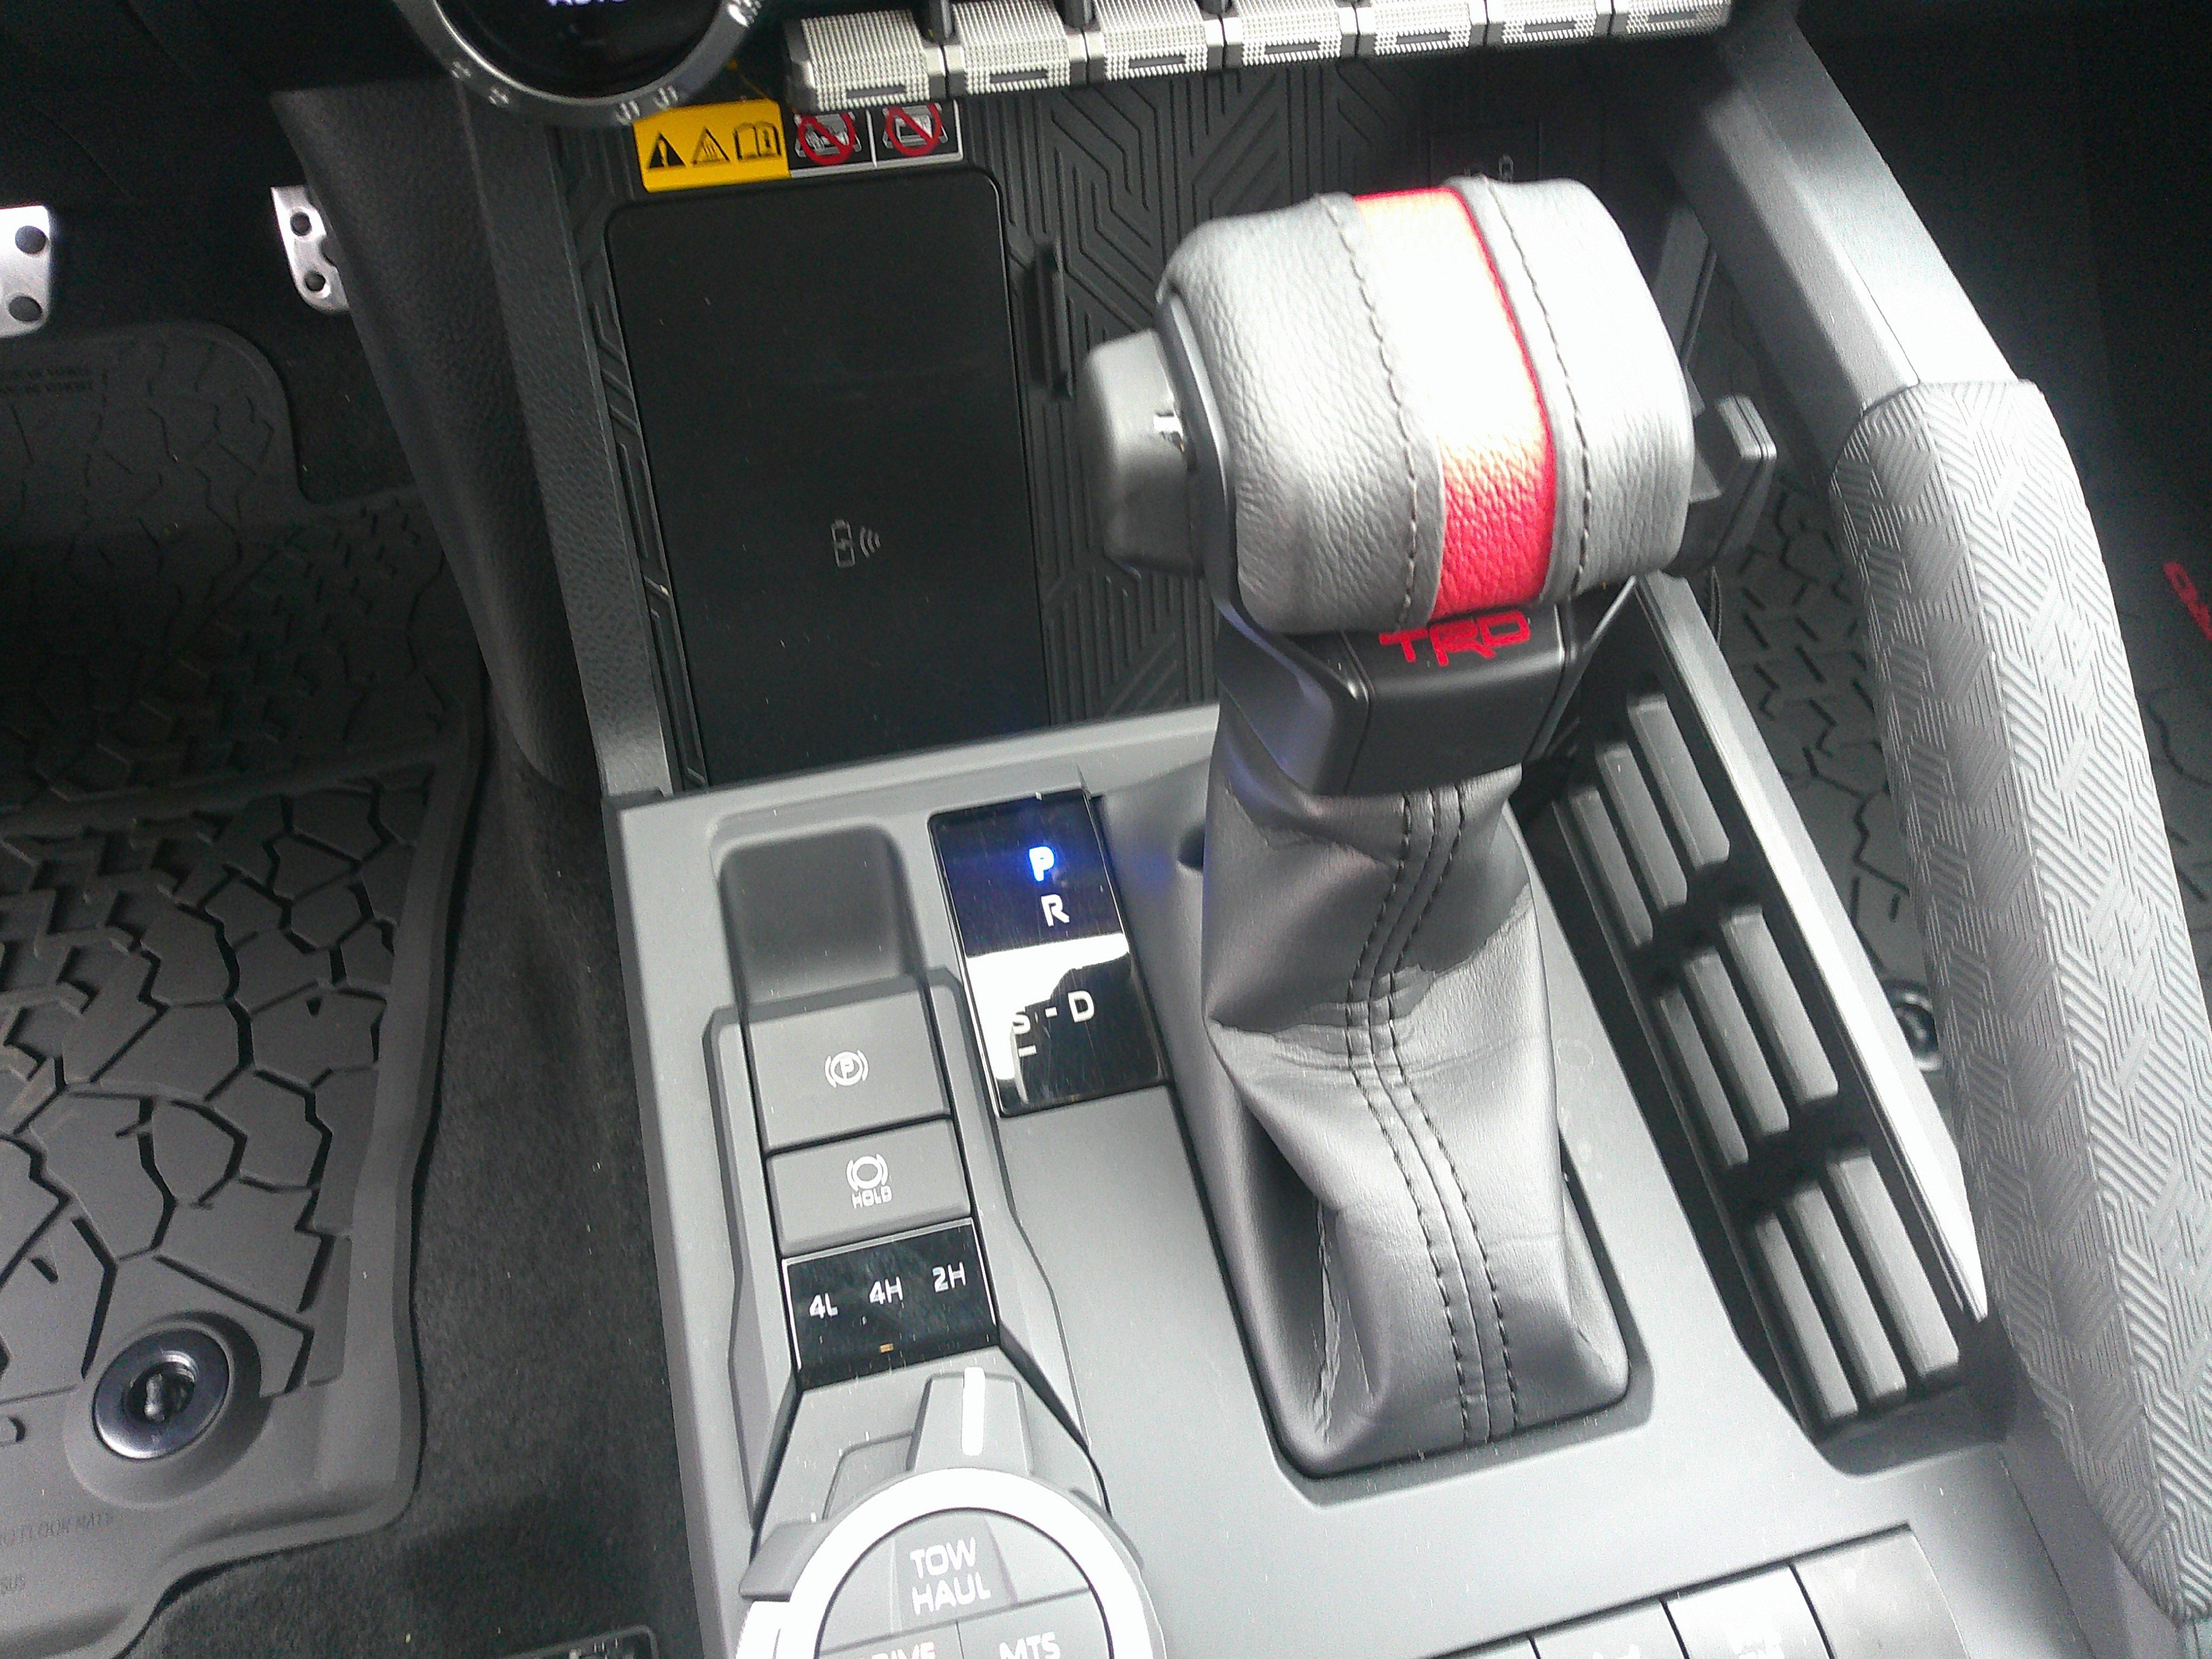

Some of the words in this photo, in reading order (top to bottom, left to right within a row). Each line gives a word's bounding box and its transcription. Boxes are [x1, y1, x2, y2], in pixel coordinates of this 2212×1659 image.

[1379, 611, 1531, 666] TRD
[1028, 846, 1055, 881] P
[1040, 894, 1071, 927] R
[1067, 990, 1094, 1023] D
[852, 1186, 893, 1209] HOLD
[808, 1292, 839, 1319] 4L
[869, 1276, 904, 1305] 4H
[931, 1261, 967, 1293] 2H
[910, 1537, 976, 1579] TOW
[912, 1572, 992, 1615] HAUL
[999, 1632, 1061, 1659] MTS
